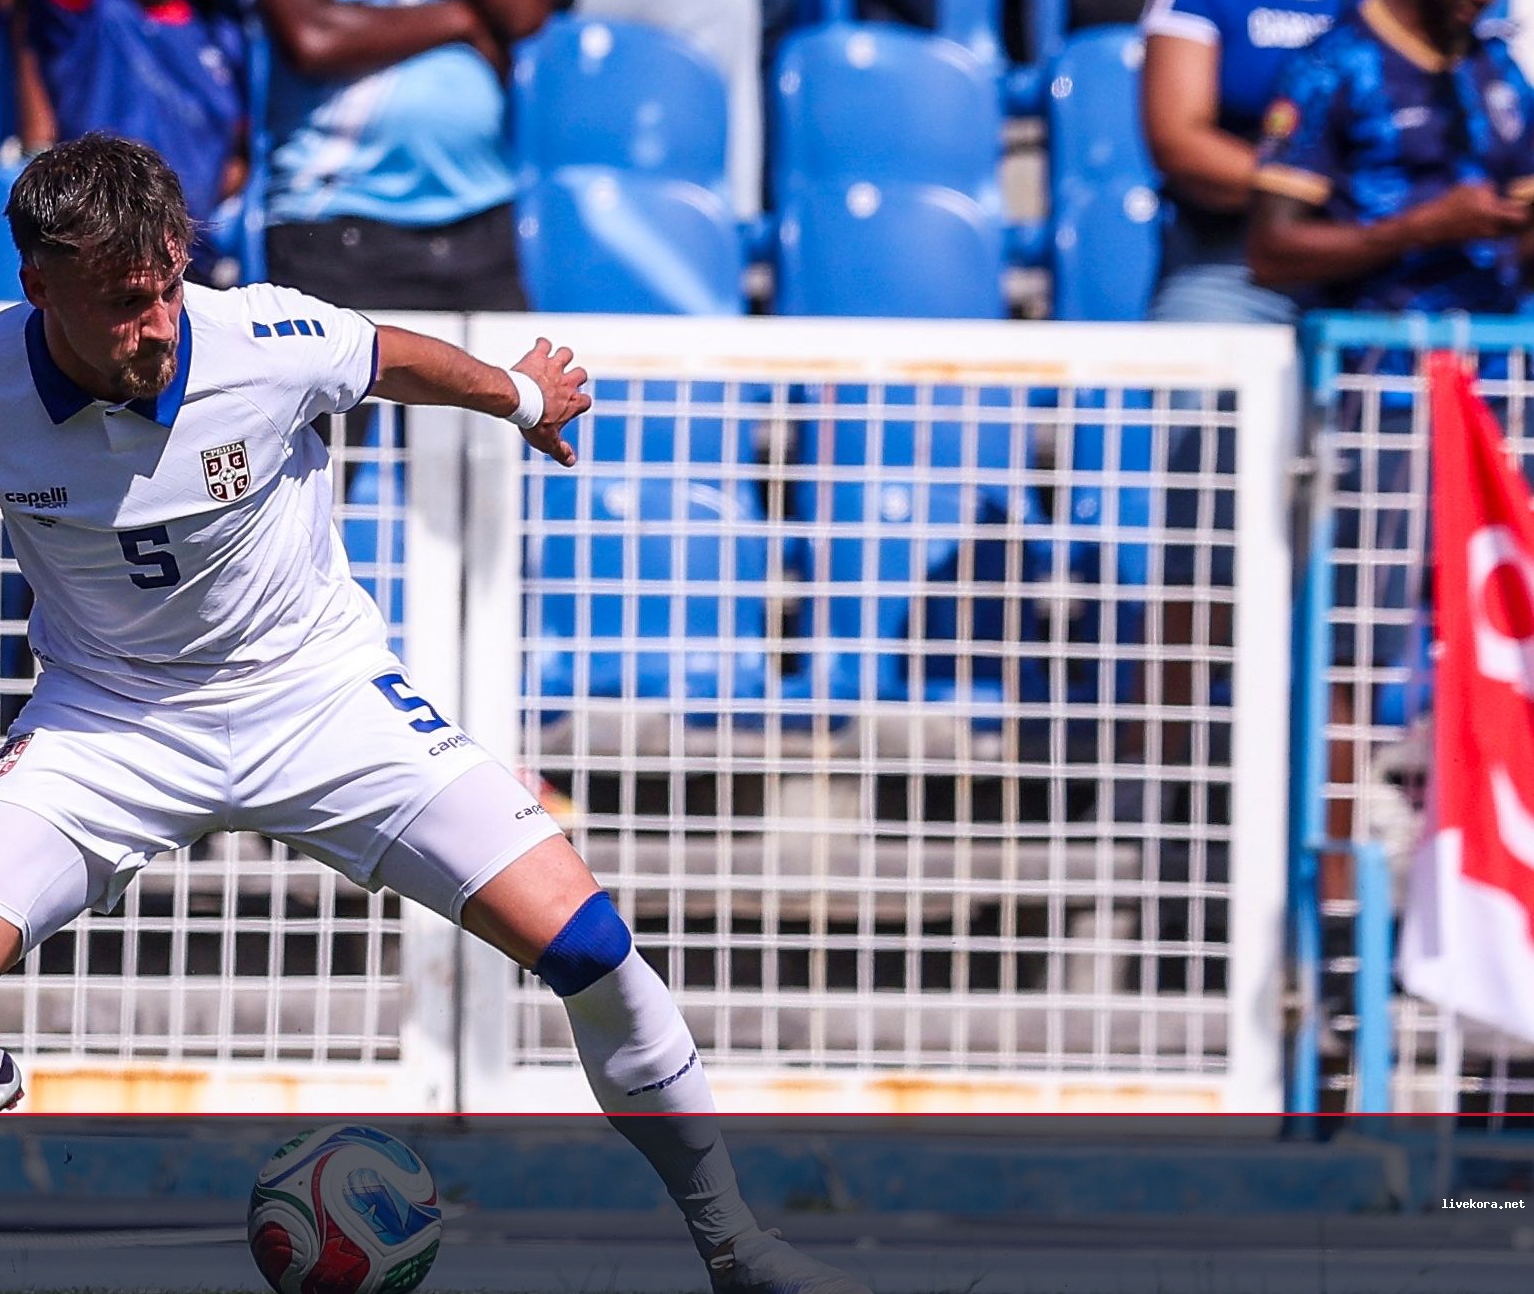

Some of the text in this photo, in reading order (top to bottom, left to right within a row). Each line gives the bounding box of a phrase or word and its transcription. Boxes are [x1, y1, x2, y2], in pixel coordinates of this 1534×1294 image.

[5, 487, 68, 506] capelli
[117, 525, 181, 589] 5
[371, 673, 451, 734] 5
